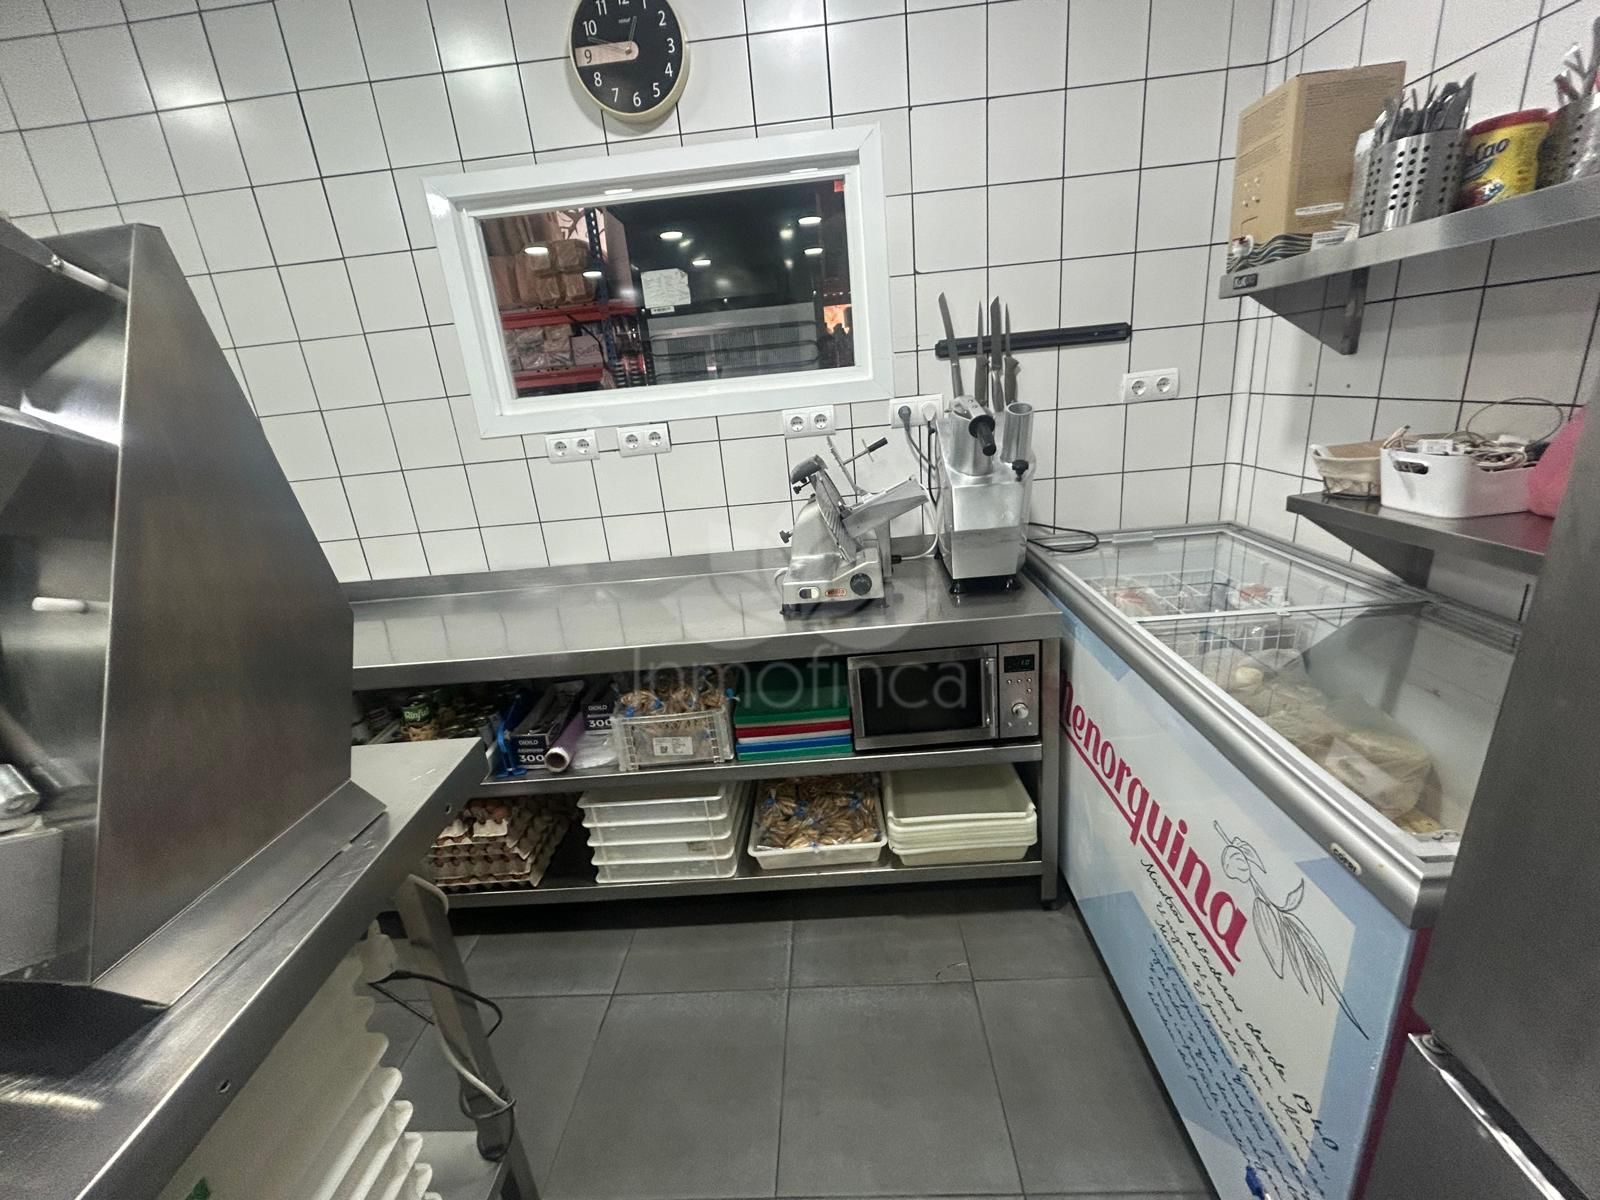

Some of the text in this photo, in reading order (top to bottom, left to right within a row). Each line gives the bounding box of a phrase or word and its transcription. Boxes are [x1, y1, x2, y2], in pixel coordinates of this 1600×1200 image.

[595, 0, 608, 16] 11
[657, 10, 667, 27] 2
[583, 19, 598, 36] 10
[666, 38, 676, 53] 3
[584, 48, 593, 64] 9
[664, 62, 673, 78] 4
[593, 71, 603, 87] 8
[611, 87, 619, 103] 7
[652, 82, 661, 98] 5
[632, 91, 642, 107] 6
[518, 754, 545, 763] 300
[1140, 859, 1338, 1151] Maestros heladeros desde 1940
